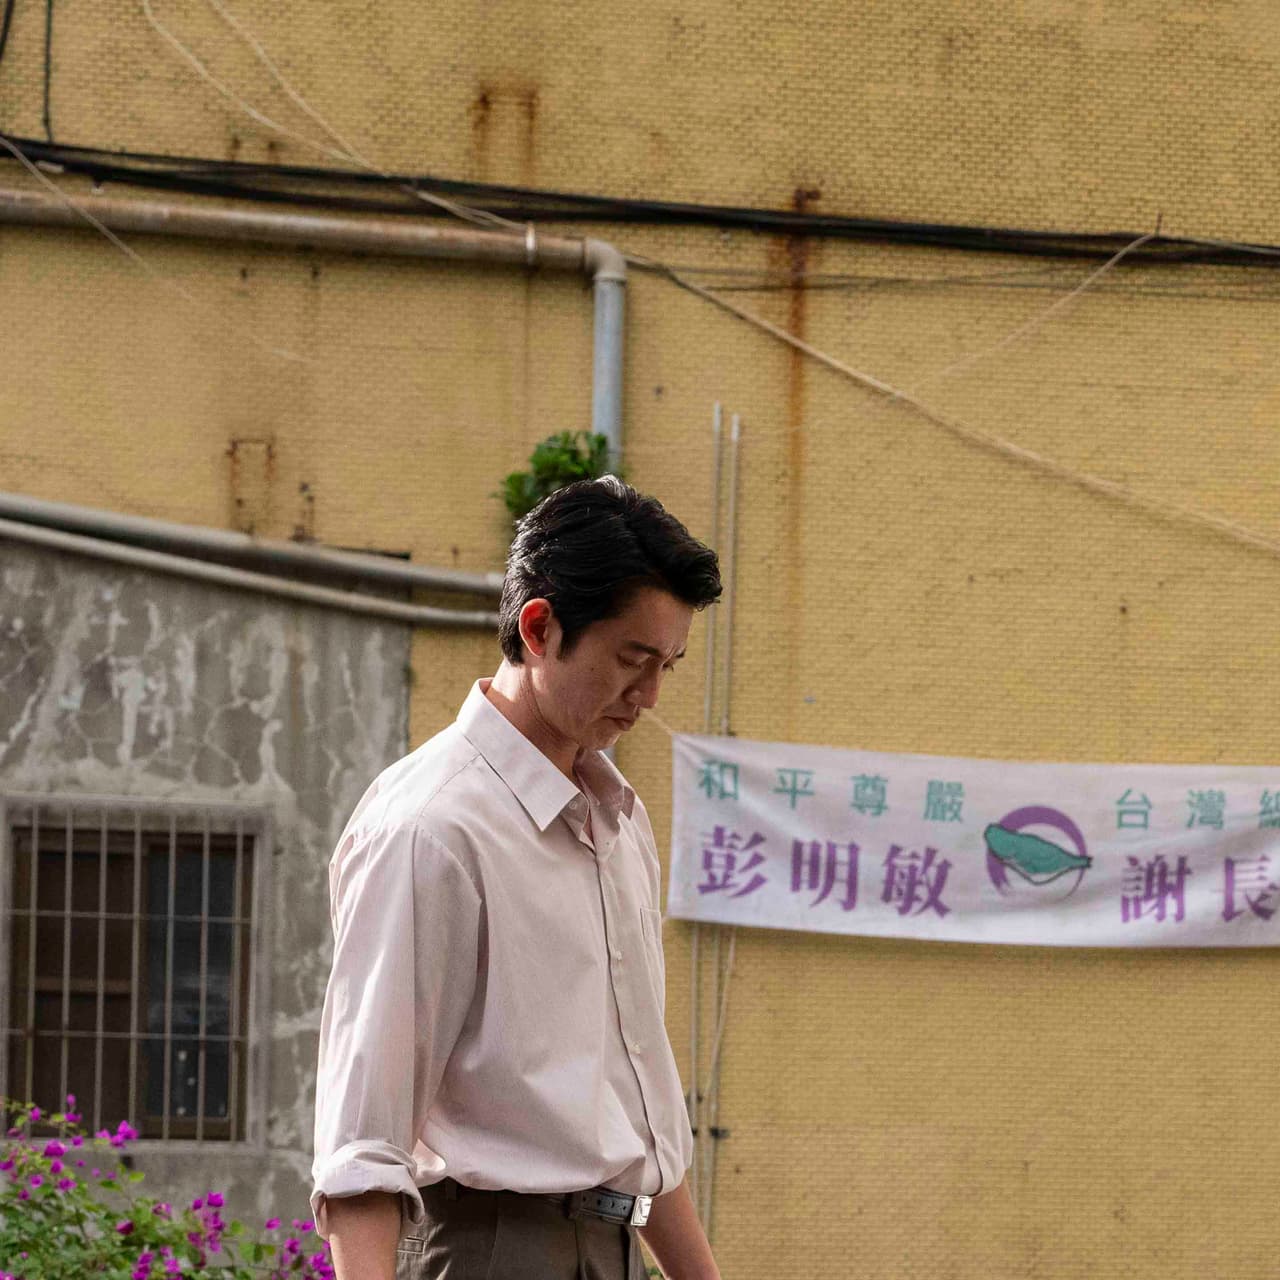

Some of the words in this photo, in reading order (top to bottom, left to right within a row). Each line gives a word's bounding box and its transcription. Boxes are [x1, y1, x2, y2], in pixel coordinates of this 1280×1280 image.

[699, 758, 965, 823] 和平尊嚴
[697, 825, 953, 919] 彭明敏
